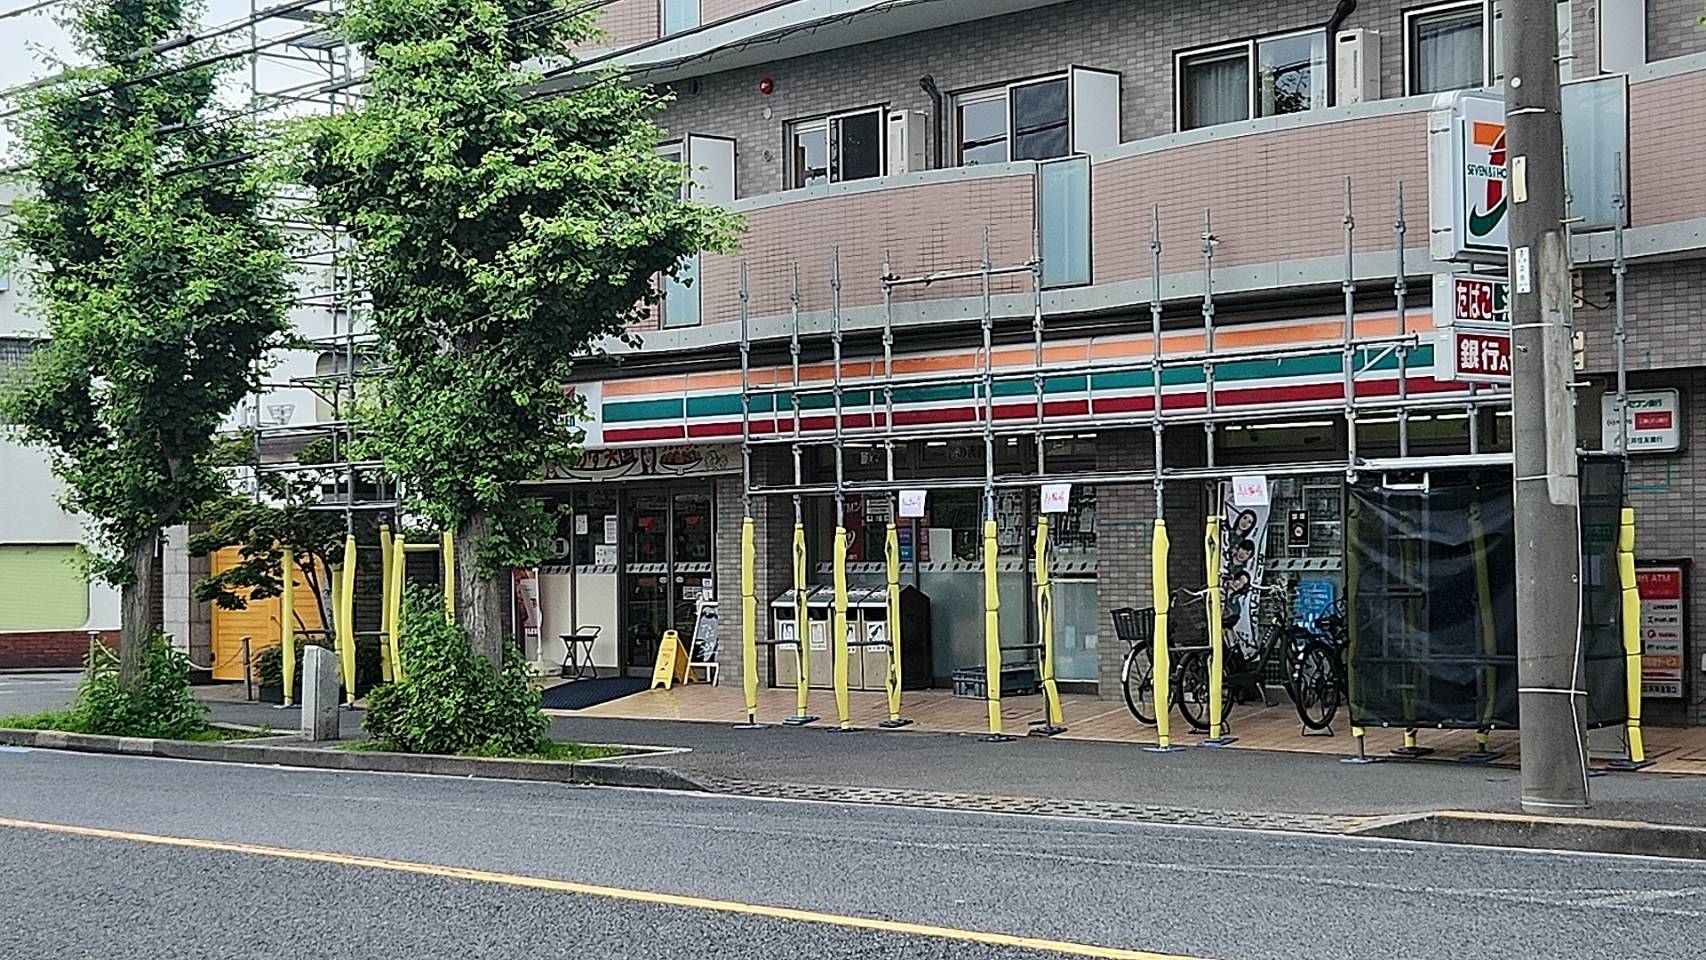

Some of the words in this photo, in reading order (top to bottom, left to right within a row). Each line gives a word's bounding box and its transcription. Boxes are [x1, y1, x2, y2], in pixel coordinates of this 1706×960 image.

[1456, 281, 1492, 320] たばこ
[1460, 338, 1511, 371] 銀行A
